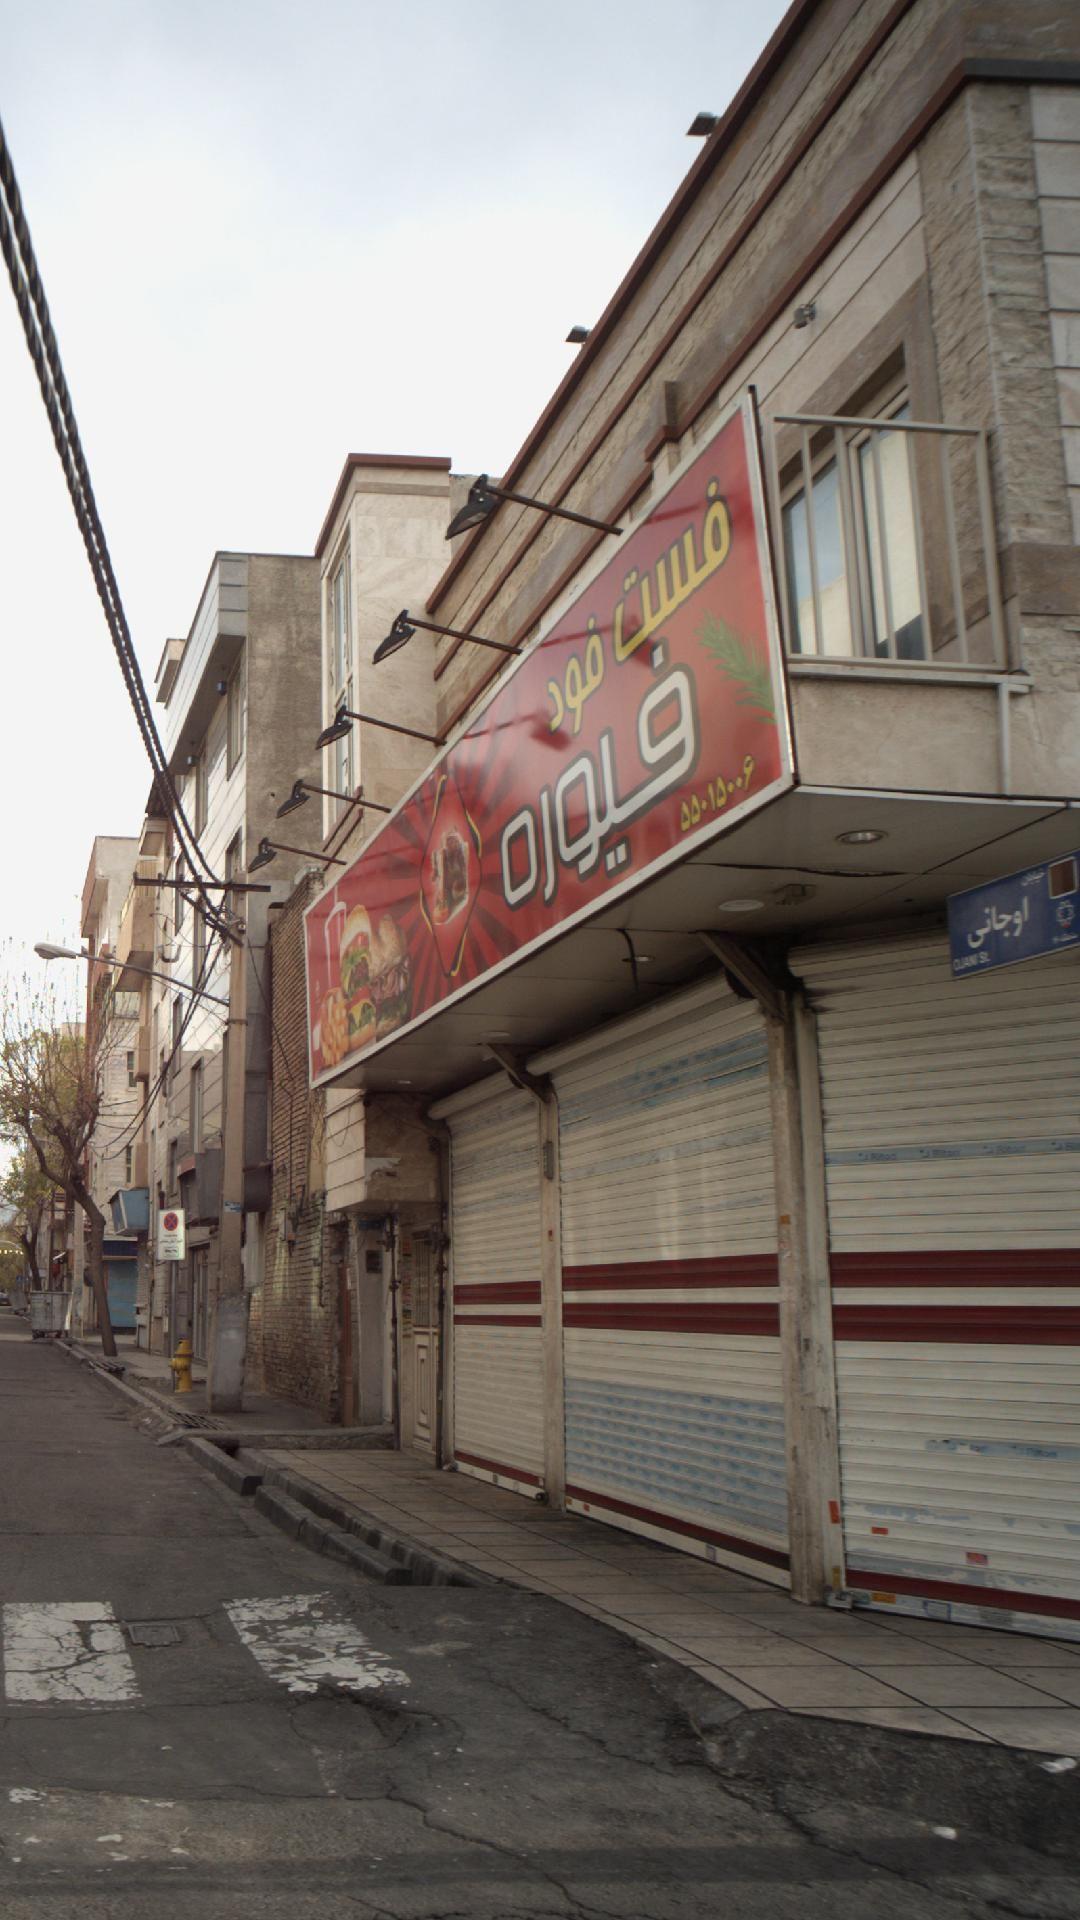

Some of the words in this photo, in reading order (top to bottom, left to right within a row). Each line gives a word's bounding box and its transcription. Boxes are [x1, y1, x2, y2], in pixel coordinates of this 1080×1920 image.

[613, 481, 730, 662] فست
[548, 617, 603, 733] فود
[967, 896, 1029, 948] اوجانی
